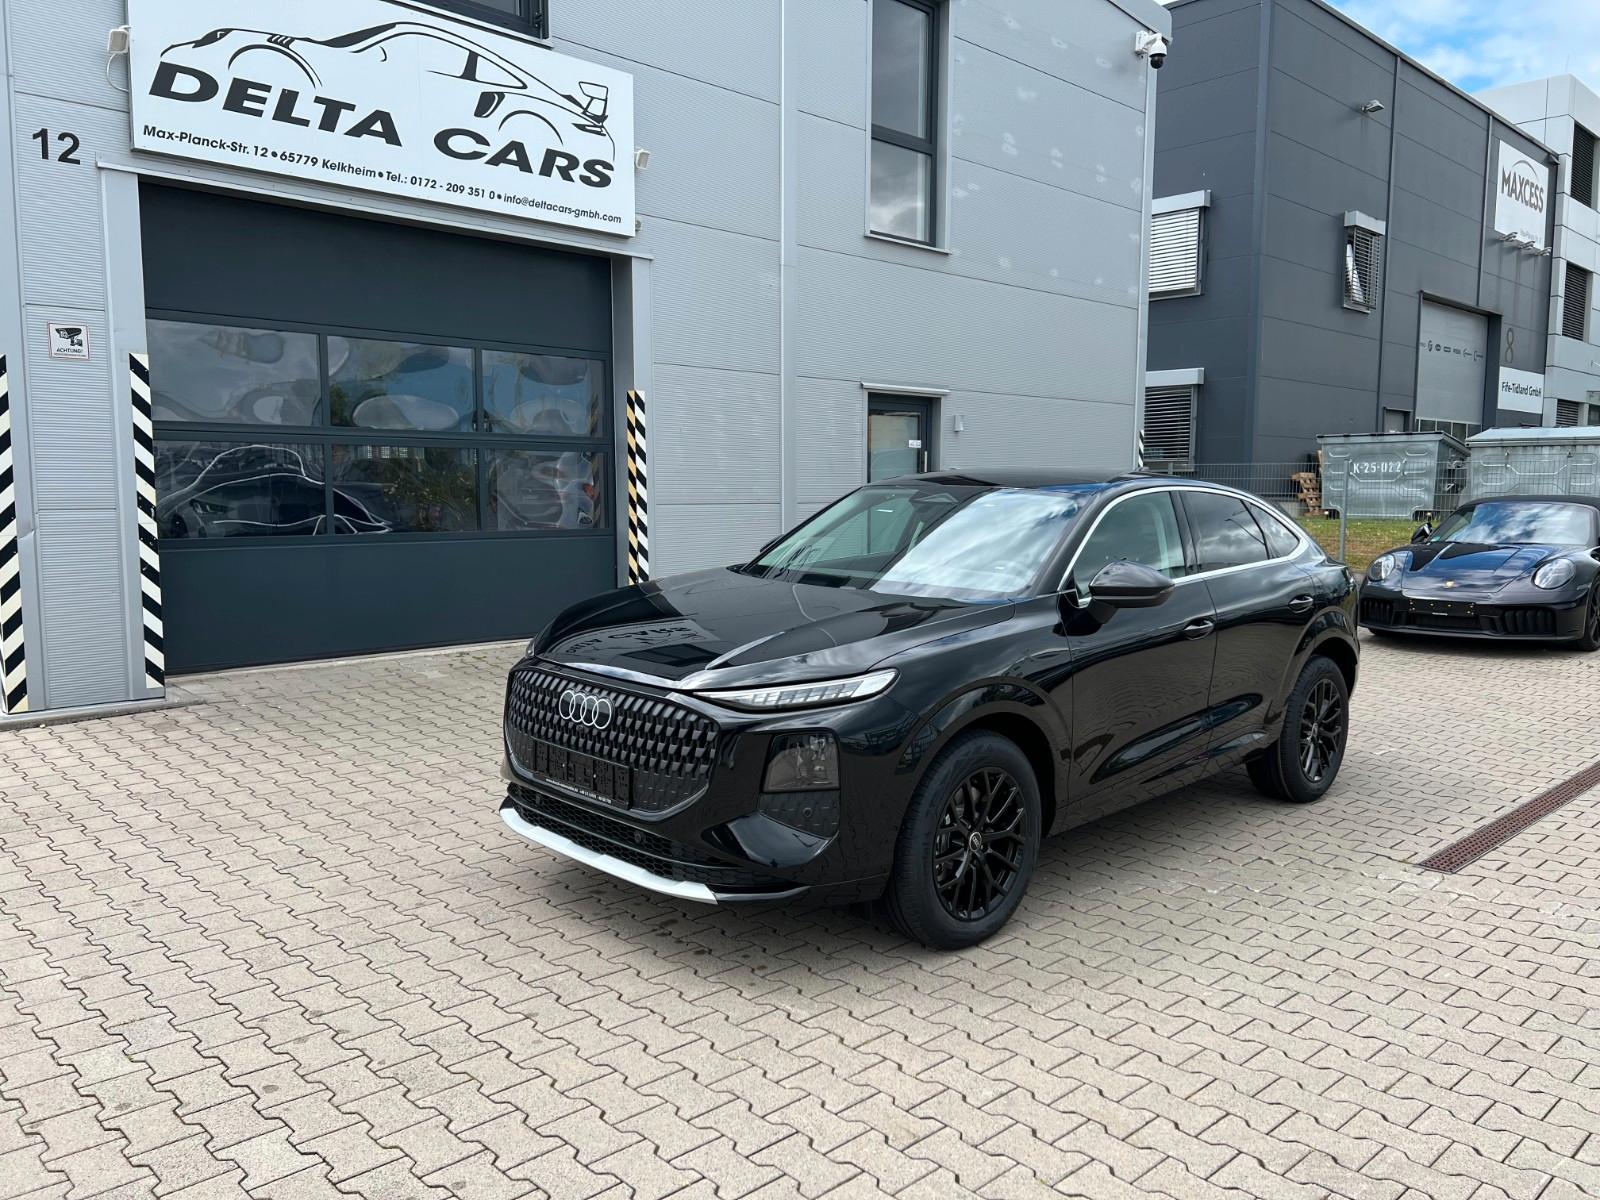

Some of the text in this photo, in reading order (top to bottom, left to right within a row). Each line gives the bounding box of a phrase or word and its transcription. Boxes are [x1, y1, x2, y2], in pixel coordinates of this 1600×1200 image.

[32, 127, 81, 166] 12
[148, 60, 615, 189] DELTA CARS
[142, 124, 250, 155] Max-Planck-Str.
[253, 145, 269, 158] 12
[279, 150, 318, 167] 65779
[321, 158, 377, 179] Kelkheim
[386, 170, 408, 184] Tel.:
[410, 175, 437, 189] 0172
[445, 182, 465, 194] 209
[467, 186, 486, 199] 351
[503, 192, 622, 224] info@deltacars-gmbh.com
[1501, 165, 1545, 214] MAXCESS
[1504, 327, 1515, 364] 8
